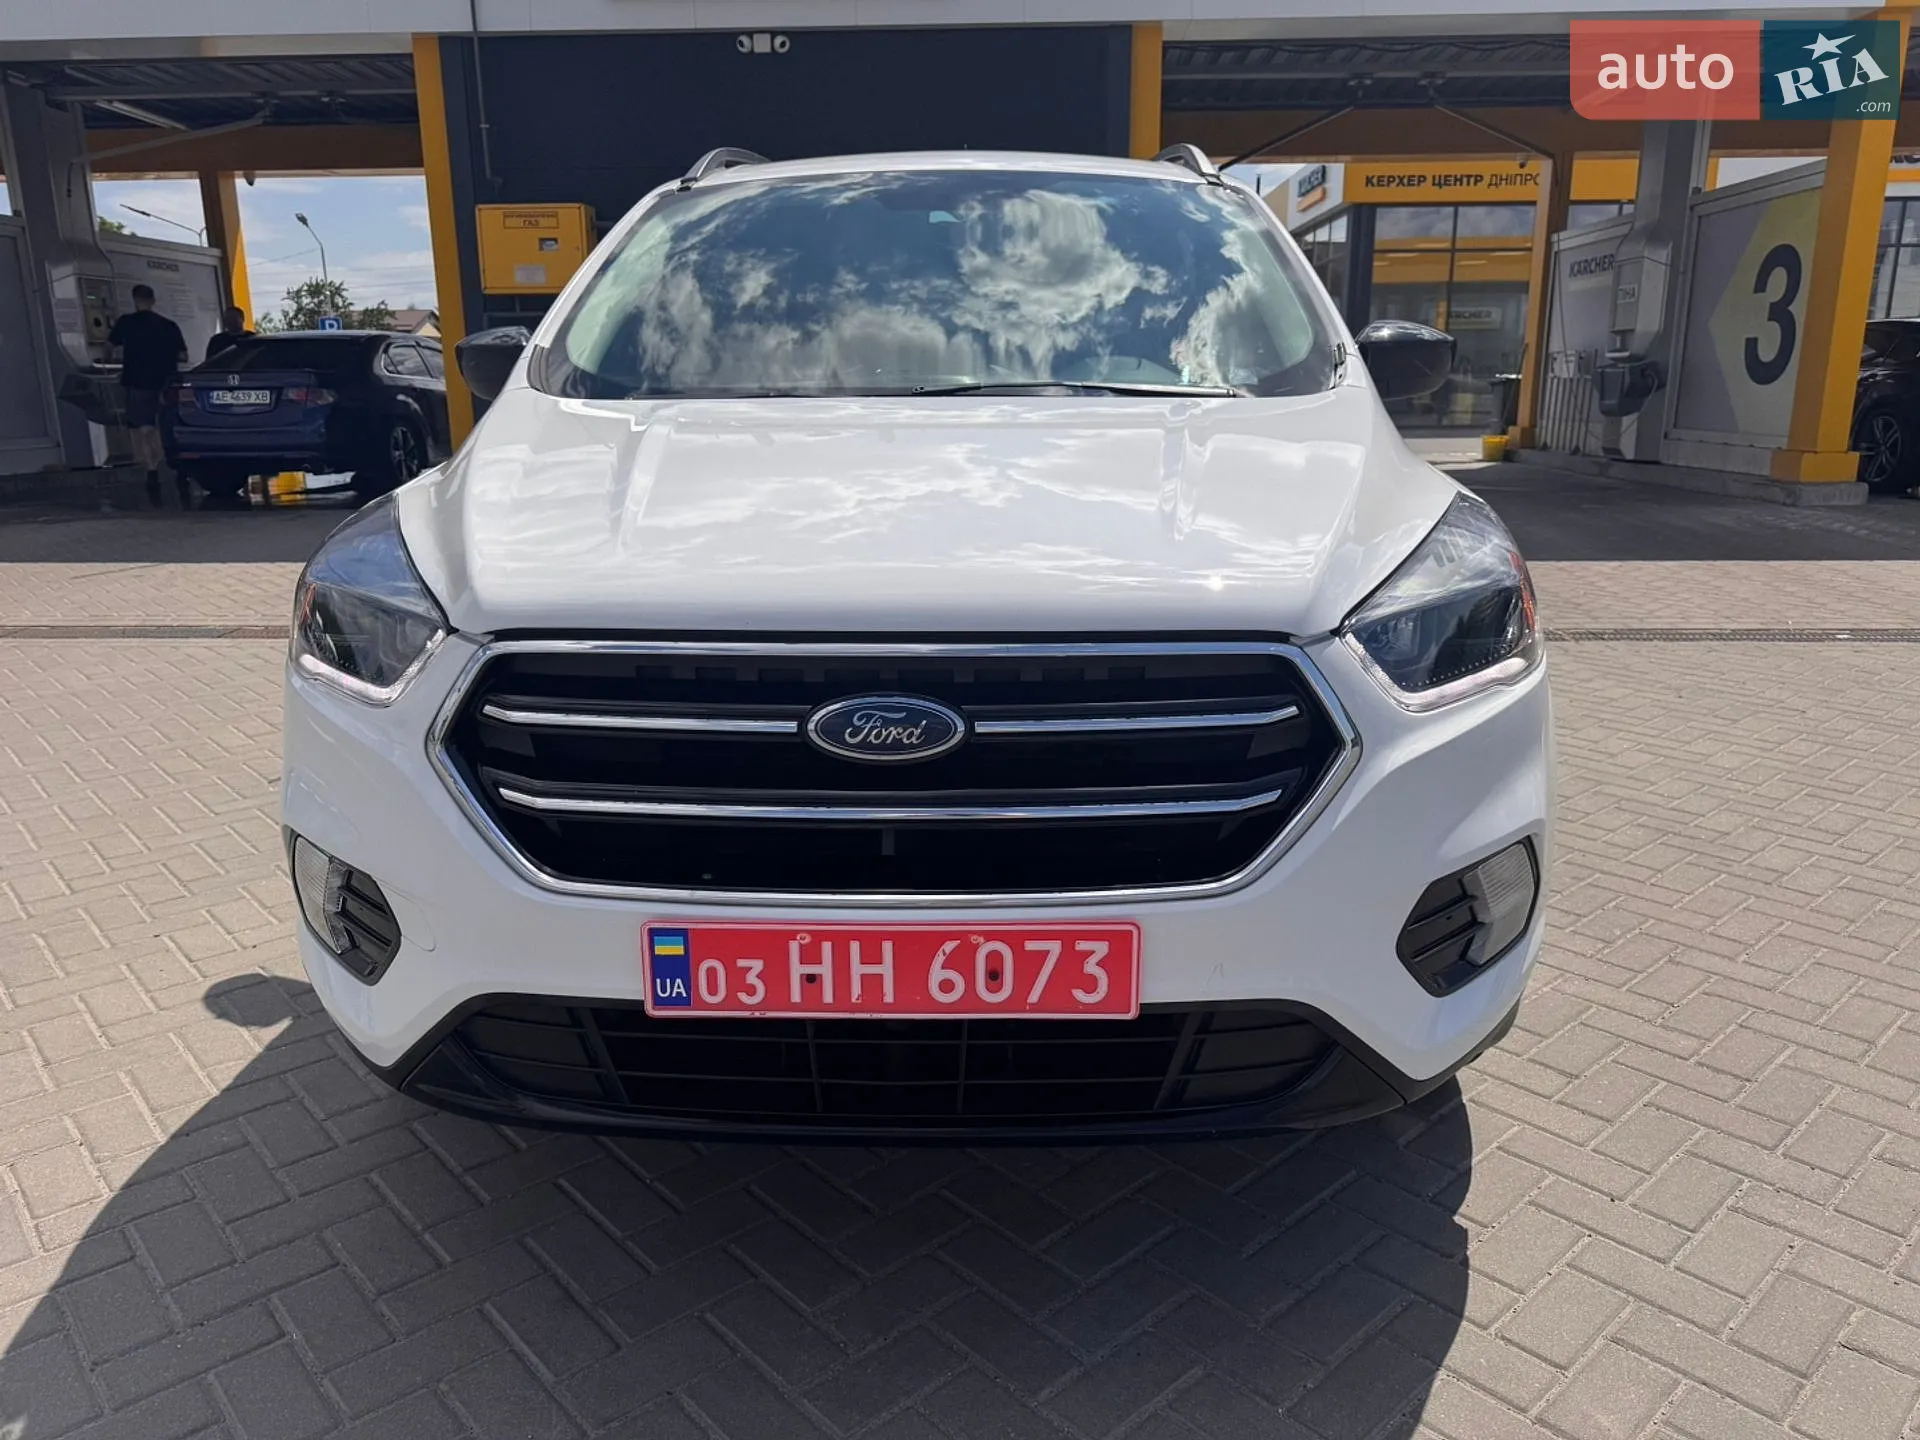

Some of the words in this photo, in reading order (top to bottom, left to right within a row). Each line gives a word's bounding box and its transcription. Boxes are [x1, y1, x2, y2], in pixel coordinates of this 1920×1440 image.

[1365, 175, 1427, 188] КЕРХЕР
[1432, 174, 1484, 189] ЦЕНТР
[1744, 243, 1802, 385] 3
[844, 710, 927, 744] Ford
[656, 978, 688, 998] UA
[699, 958, 766, 1005] 03
[788, 940, 895, 1003] HH
[928, 940, 1110, 1004] 6073
